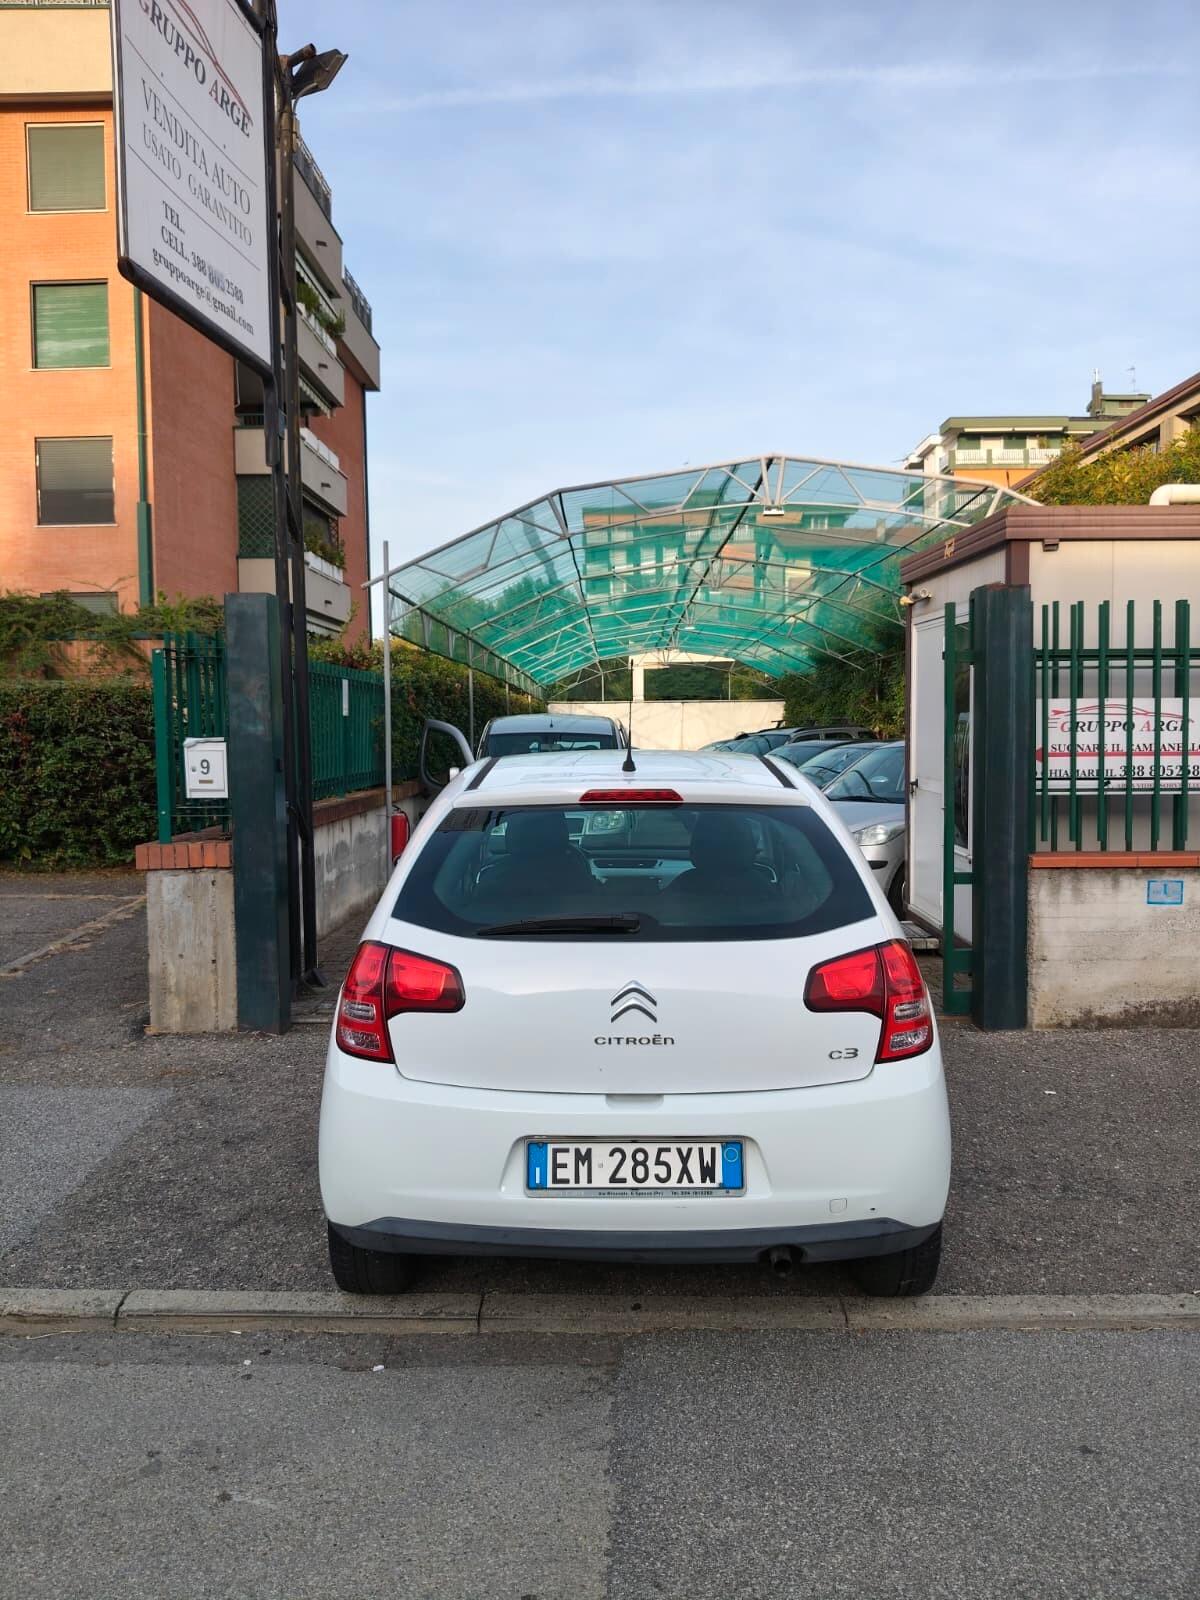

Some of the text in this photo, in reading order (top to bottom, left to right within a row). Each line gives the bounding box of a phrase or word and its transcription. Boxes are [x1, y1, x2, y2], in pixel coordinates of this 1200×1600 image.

[139, 0, 250, 138] GRUPPO ARGE
[141, 77, 250, 214] VENDITA AUTO
[143, 121, 252, 246] USATO GARANTITO
[1140, 719, 1187, 732] ARG
[200, 758, 210, 775] 9
[828, 1047, 859, 1060] C3
[552, 1147, 592, 1184] EM
[608, 1147, 716, 1184] 285XW
